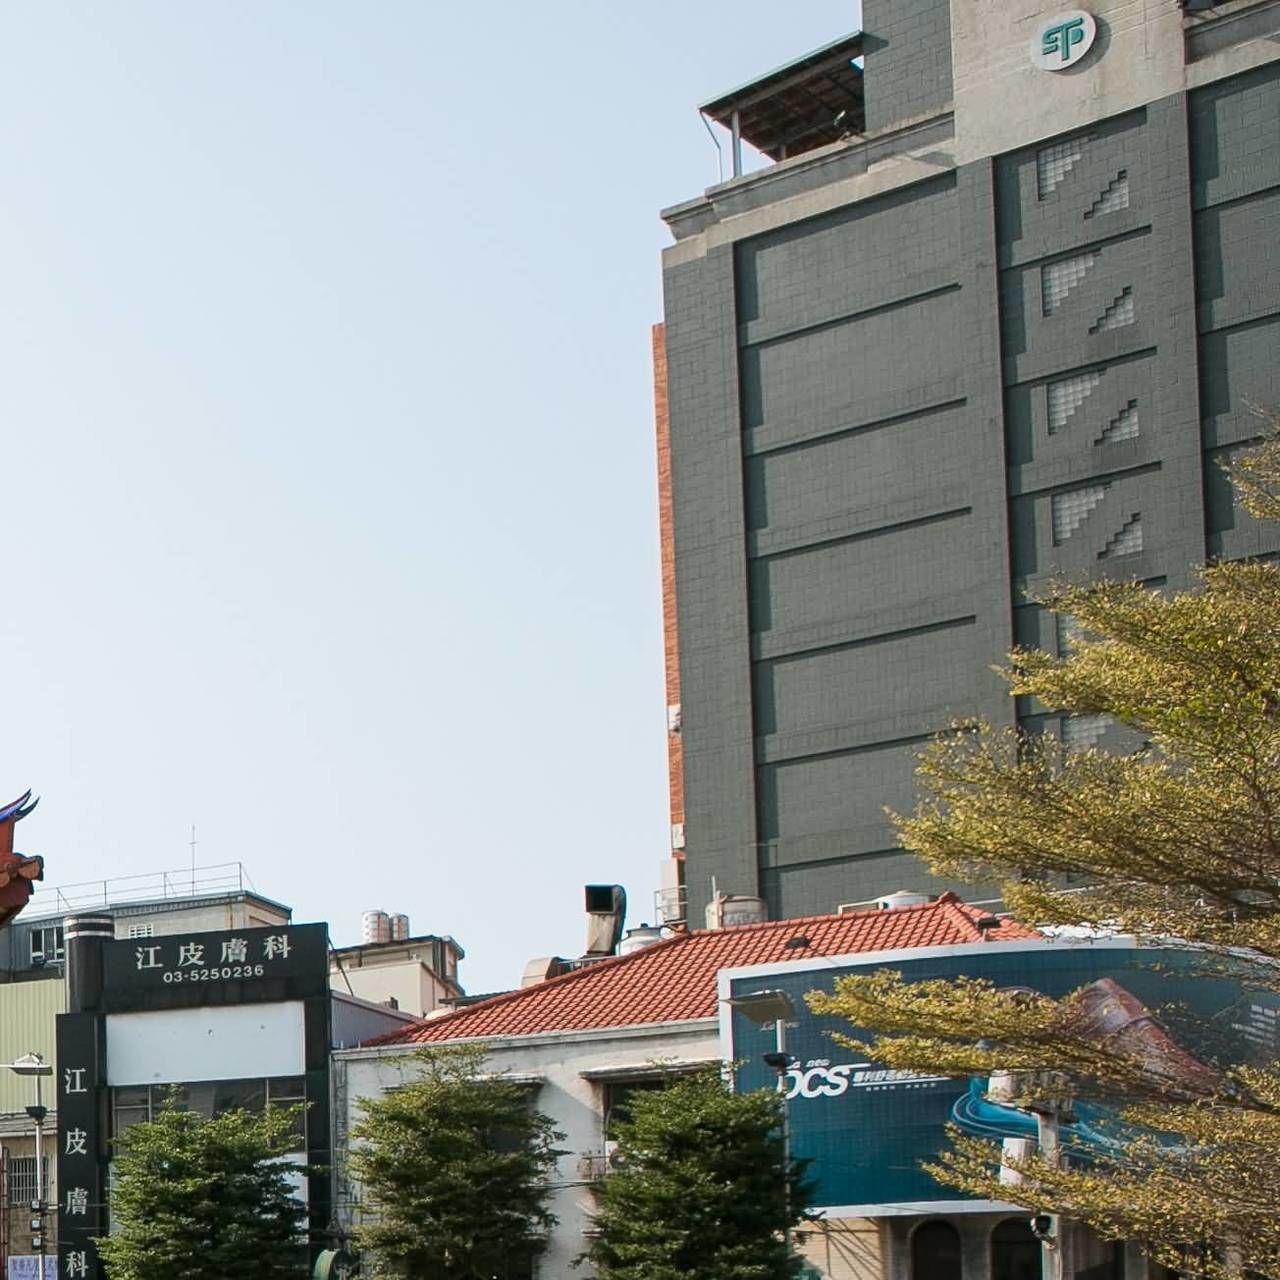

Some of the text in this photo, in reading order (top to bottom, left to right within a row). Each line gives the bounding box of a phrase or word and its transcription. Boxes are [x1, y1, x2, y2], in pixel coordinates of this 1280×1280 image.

[135, 934, 292, 970] 江皮膚科
[163, 965, 265, 983] 03-5250236
[64, 1067, 89, 1279] 江皮膚科
